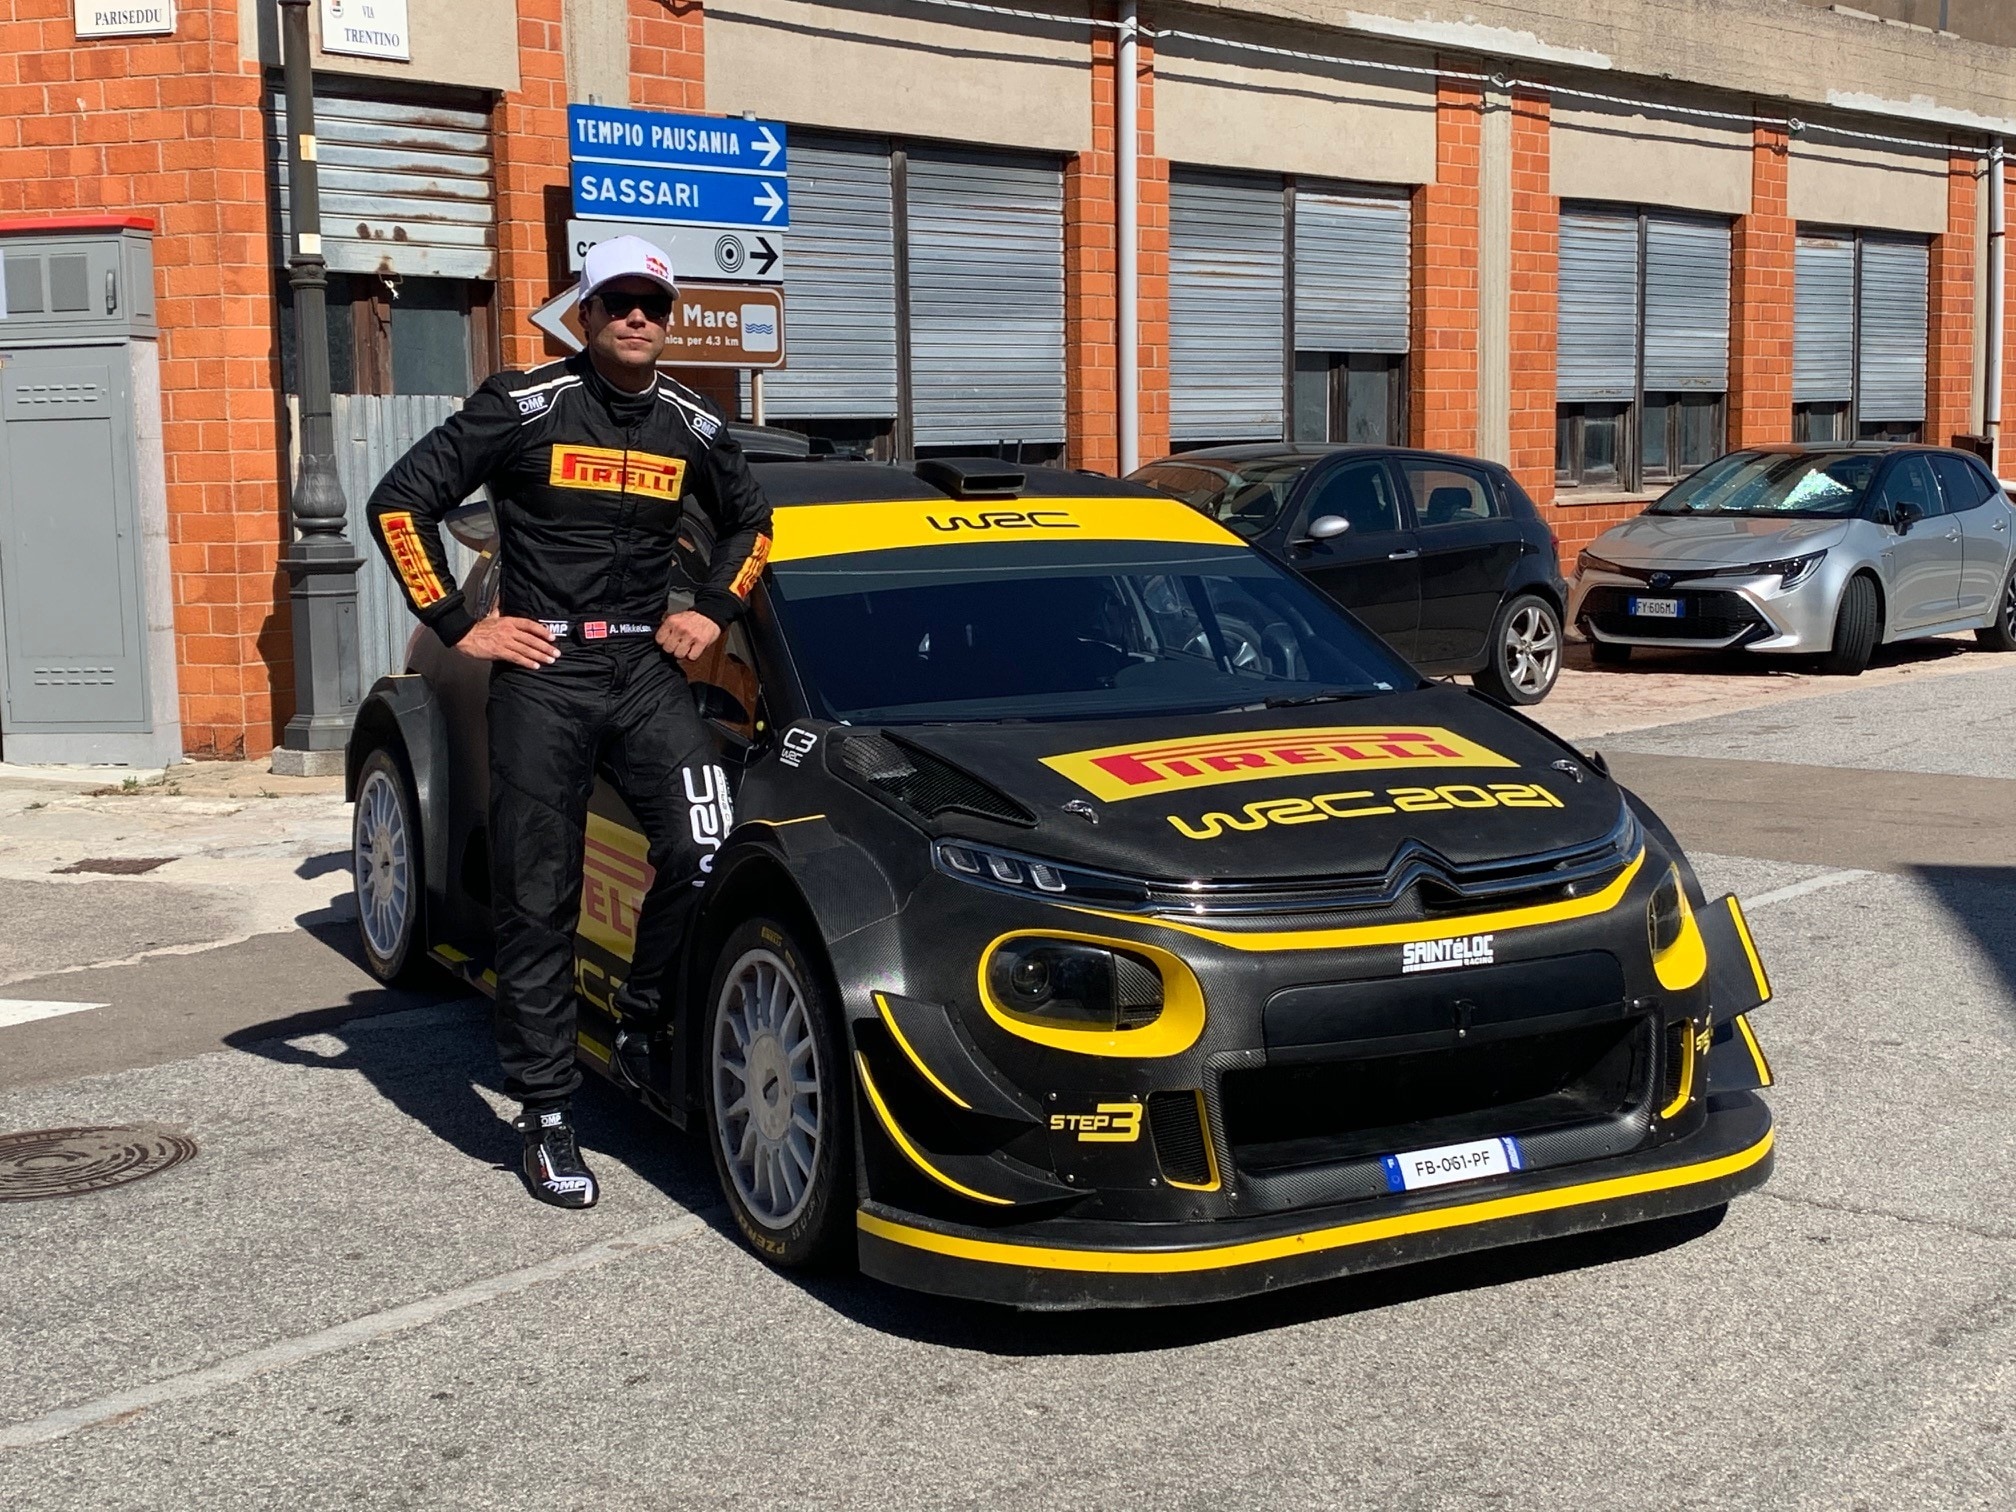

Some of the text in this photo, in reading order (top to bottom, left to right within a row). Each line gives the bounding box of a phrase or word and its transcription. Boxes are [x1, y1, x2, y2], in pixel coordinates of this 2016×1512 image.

[95, 9, 161, 25] PARISEDDU
[362, 6, 375, 18] VIA
[344, 28, 400, 47] TRENTINO
[577, 118, 740, 155] TEMPIO PAUSANIA
[580, 175, 699, 208] SASSARI
[683, 304, 738, 328] Mare
[687, 336, 702, 346] per
[725, 336, 739, 346] km
[519, 396, 545, 413] OMP
[692, 416, 716, 436] OMP
[561, 453, 678, 492] PIRELLI
[926, 512, 1081, 531] WRC
[1089, 733, 1463, 786] PIRELLI
[541, 1115, 561, 1125] OMP
[1415, 1151, 1490, 1176] FB-061-PF
[547, 1181, 586, 1192] OMP
